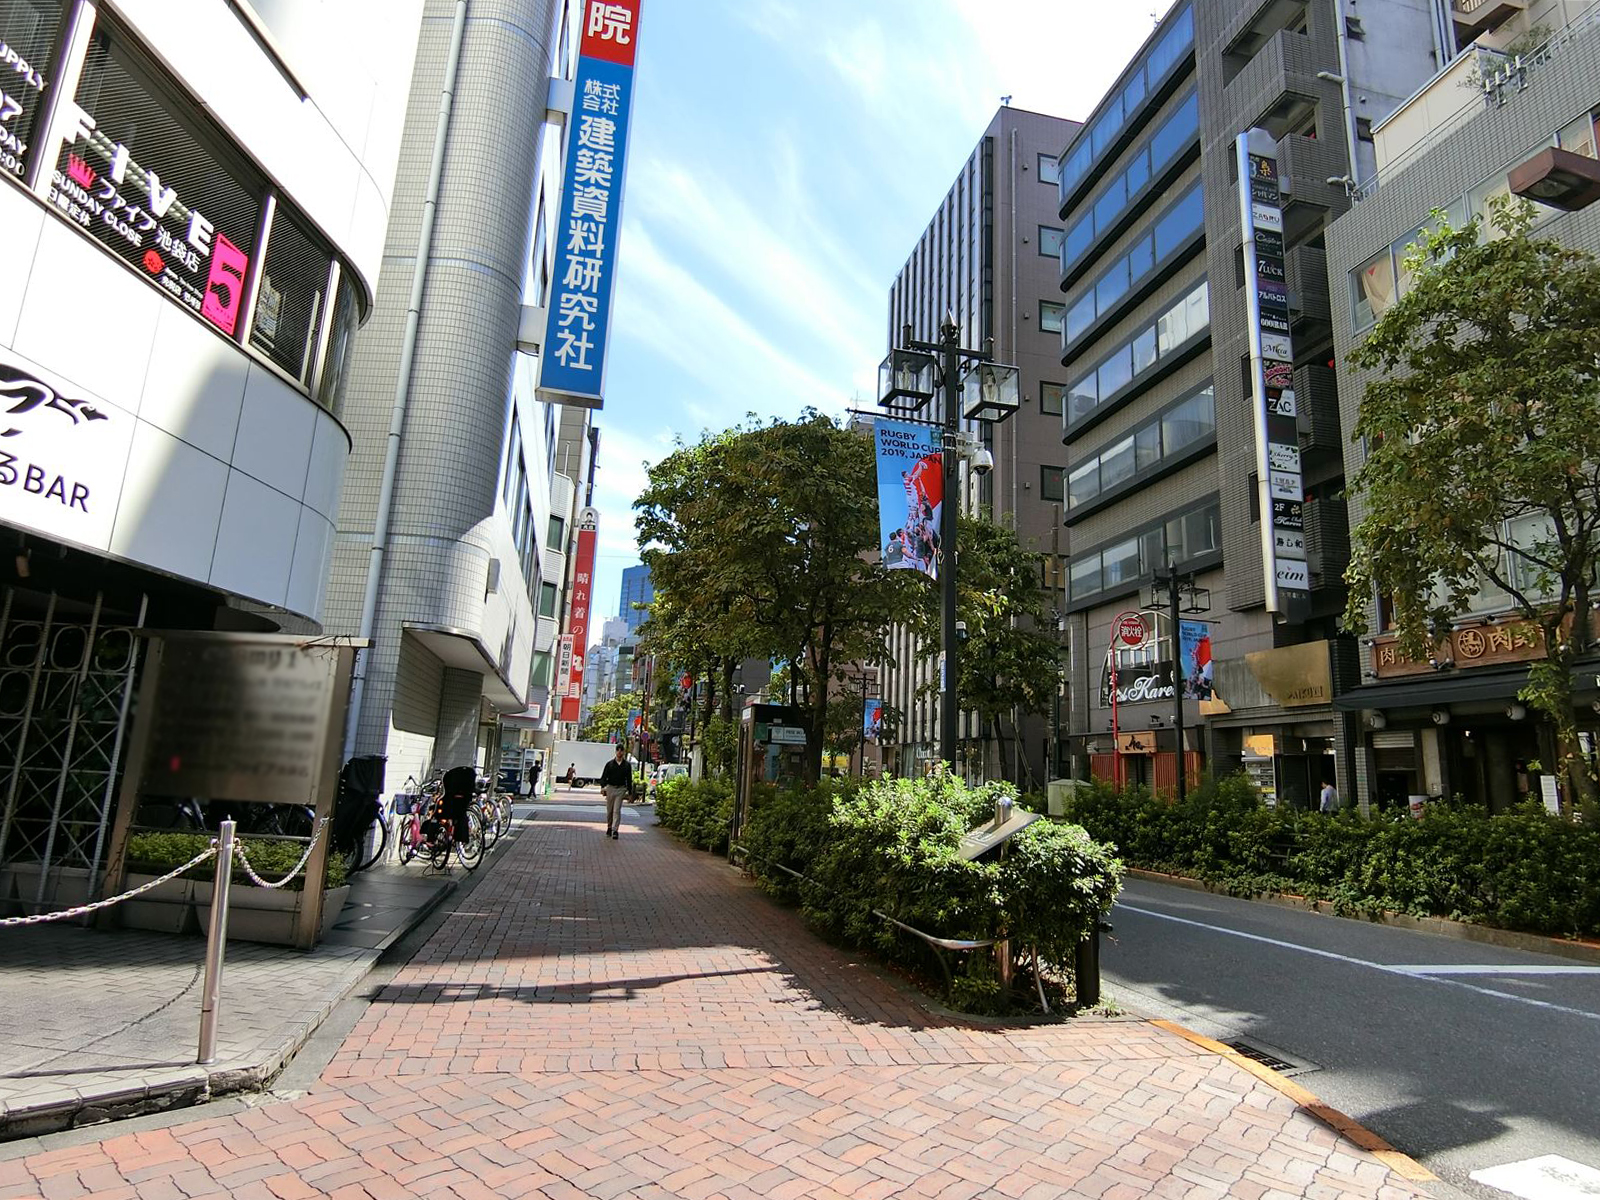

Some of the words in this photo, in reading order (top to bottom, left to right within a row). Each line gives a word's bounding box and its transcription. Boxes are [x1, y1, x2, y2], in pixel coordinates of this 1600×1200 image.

[587, 1, 632, 45] 院
[51, 169, 105, 215] SUNDAY
[103, 210, 143, 247] CLOSE
[554, 114, 616, 371] 建築資料研究社
[880, 429, 917, 441] RUGBY
[880, 438, 920, 450] WORLD
[920, 444, 941, 454] CUP
[881, 448, 908, 459] 2019,
[1274, 503, 1285, 512] 2F
[1121, 625, 1143, 637] 消火栓
